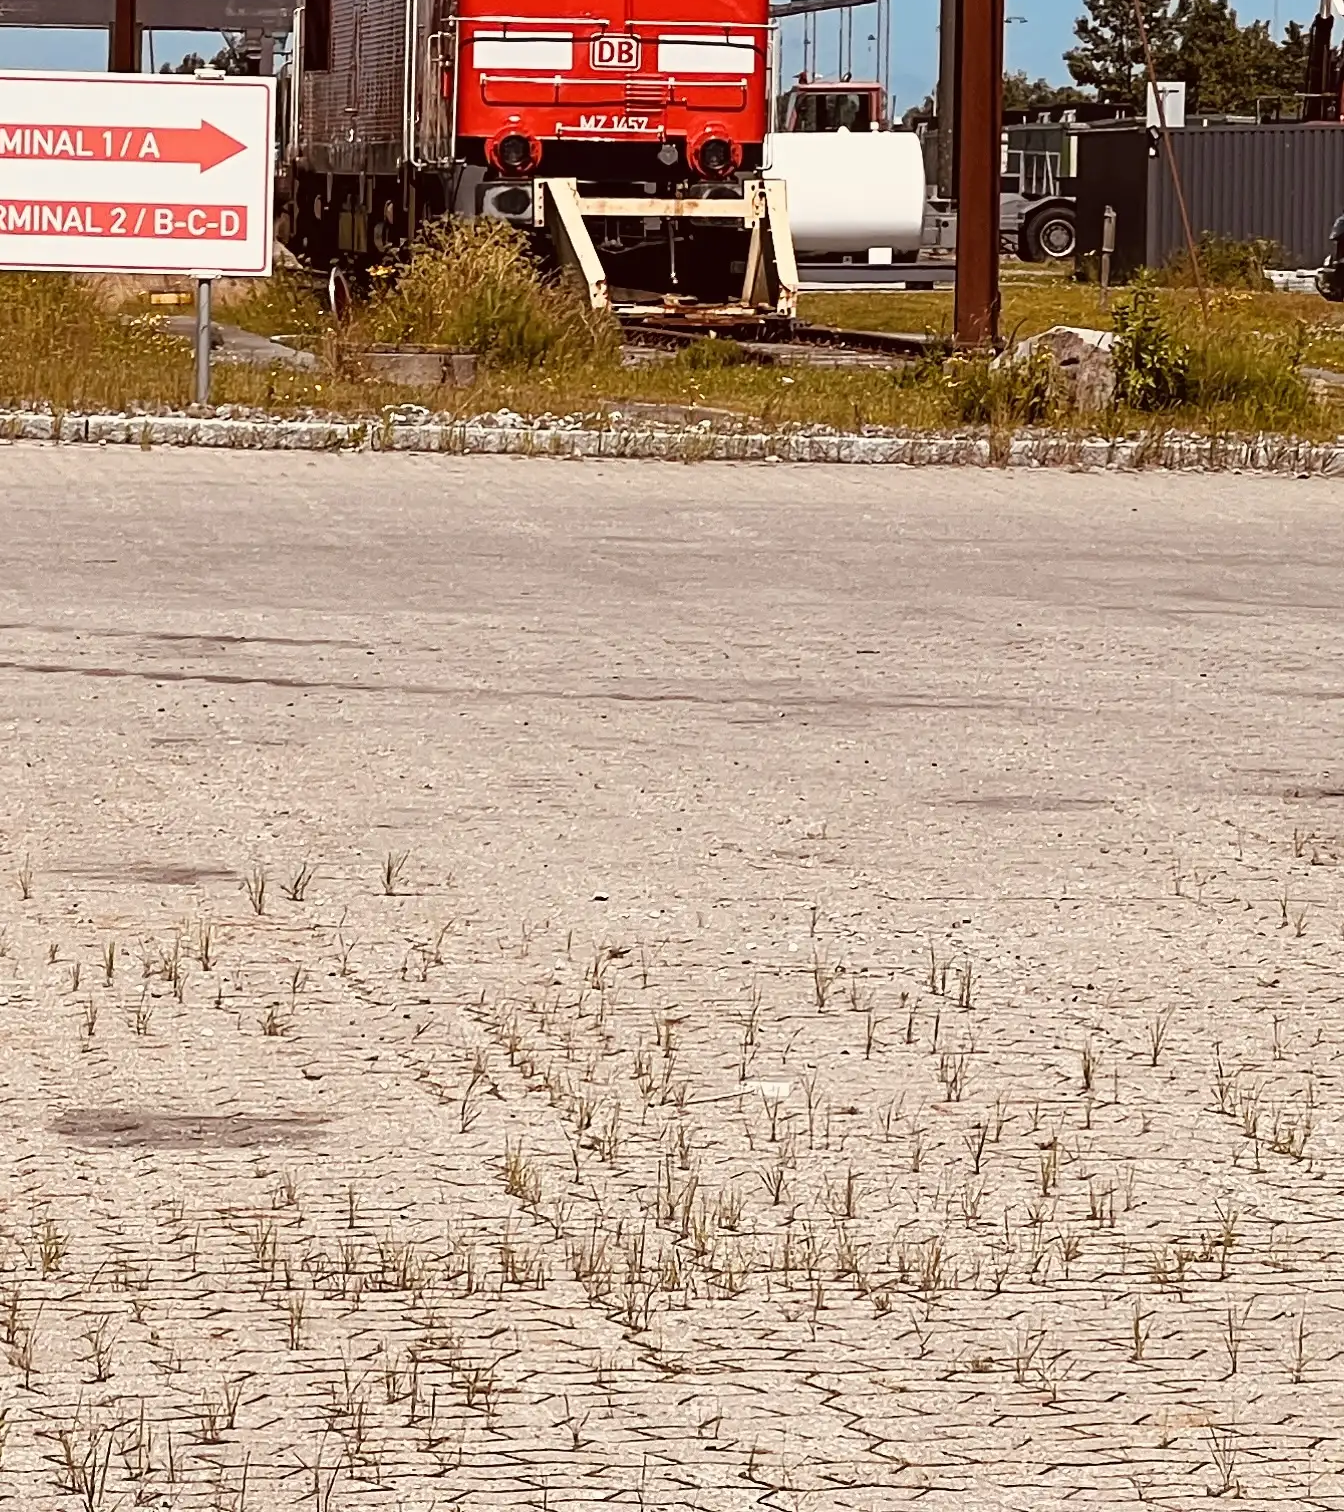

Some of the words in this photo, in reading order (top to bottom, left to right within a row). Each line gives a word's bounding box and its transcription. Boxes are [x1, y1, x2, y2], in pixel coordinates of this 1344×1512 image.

[598, 40, 634, 64] DB
[579, 115, 607, 130] MZ
[612, 116, 649, 130] 1457
[154, 208, 240, 237] B-C-D
